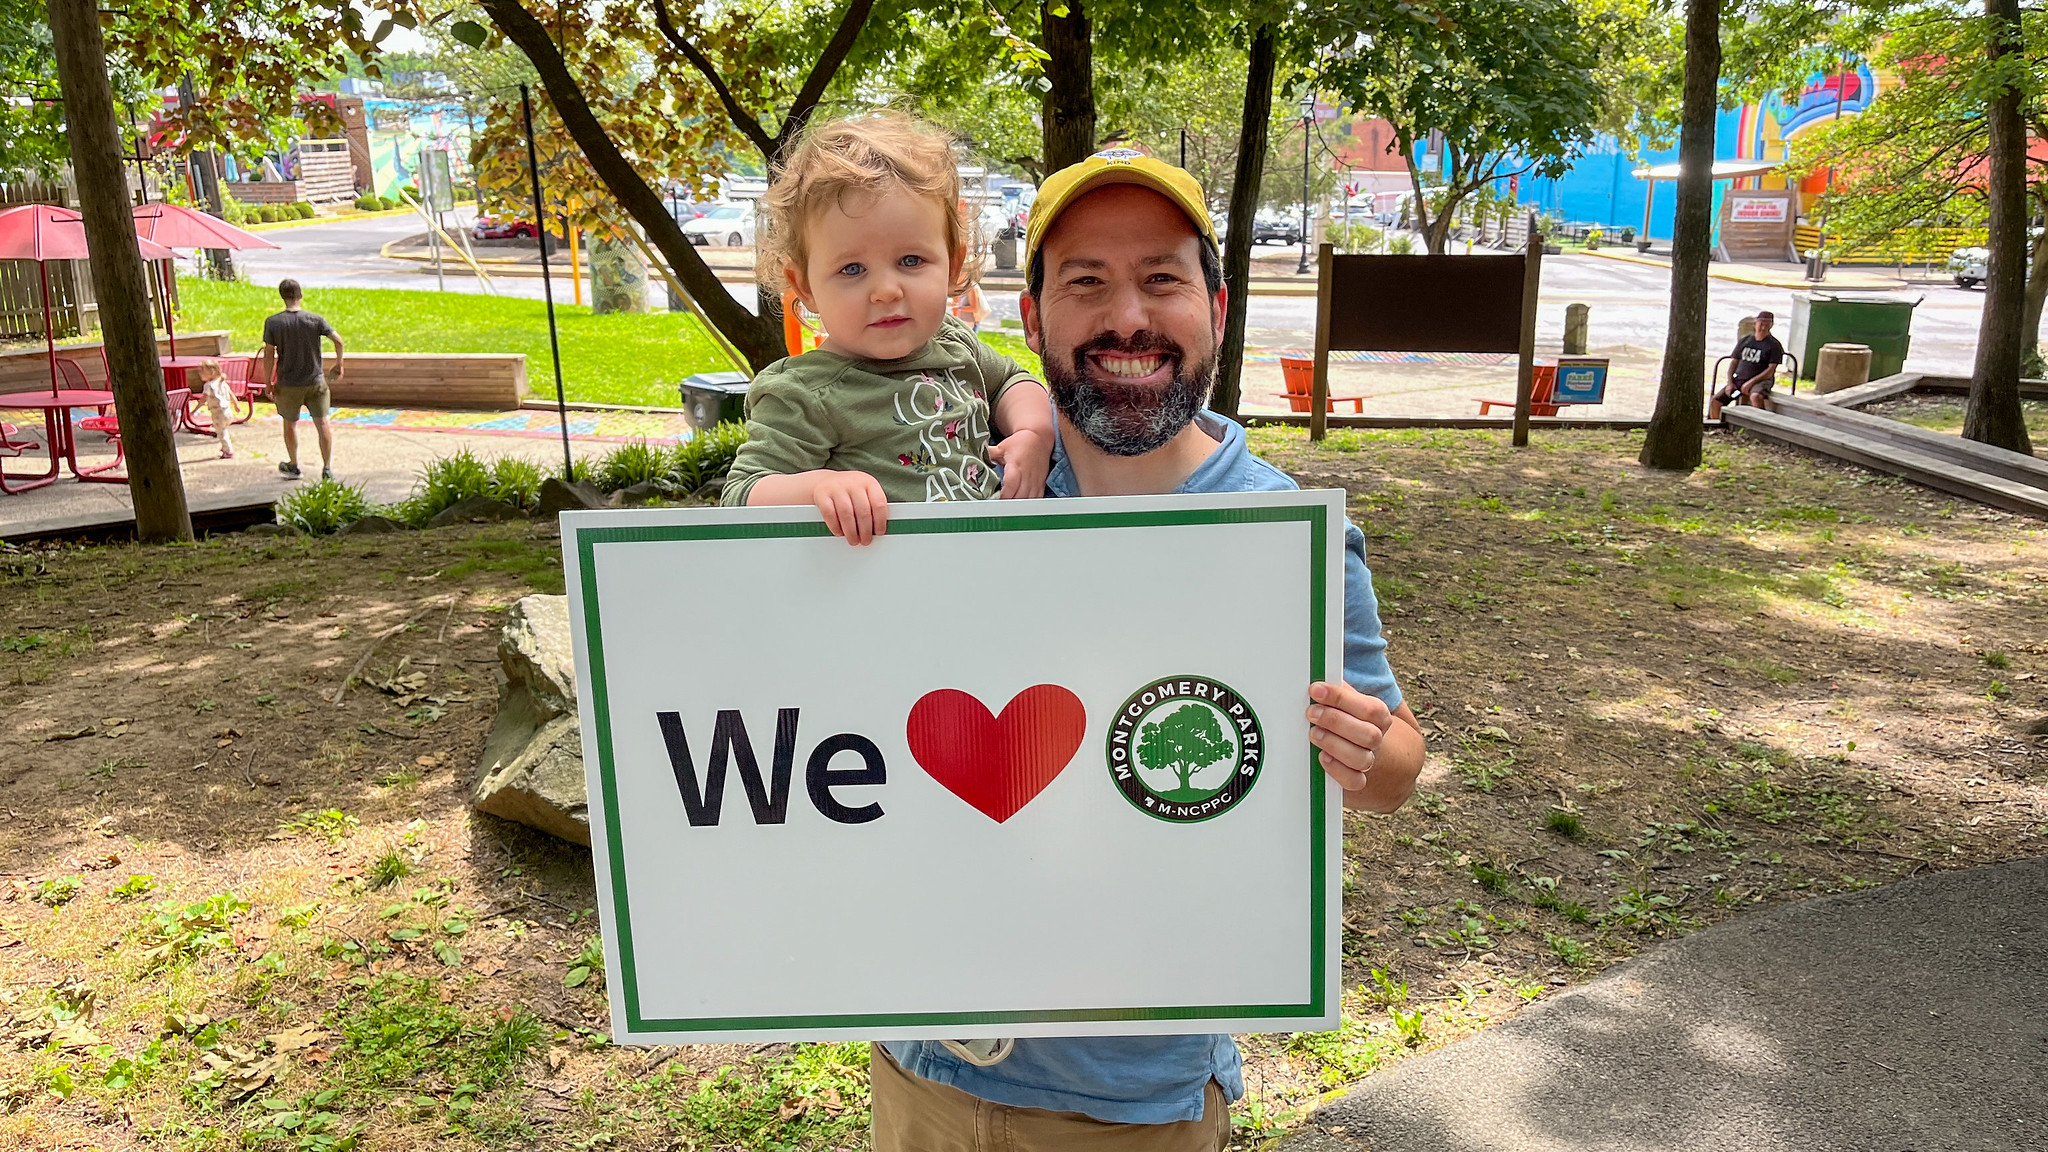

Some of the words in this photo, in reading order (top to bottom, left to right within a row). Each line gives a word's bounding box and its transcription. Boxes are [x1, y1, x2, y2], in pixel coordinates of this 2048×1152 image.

[1741, 347, 1762, 362] USA
[919, 420, 952, 465] IS
[1112, 681, 1226, 781] MONTGOMERY
[1228, 702, 1259, 777] PARKS
[656, 708, 887, 826] We
[1158, 792, 1232, 817] M-NCPPC
